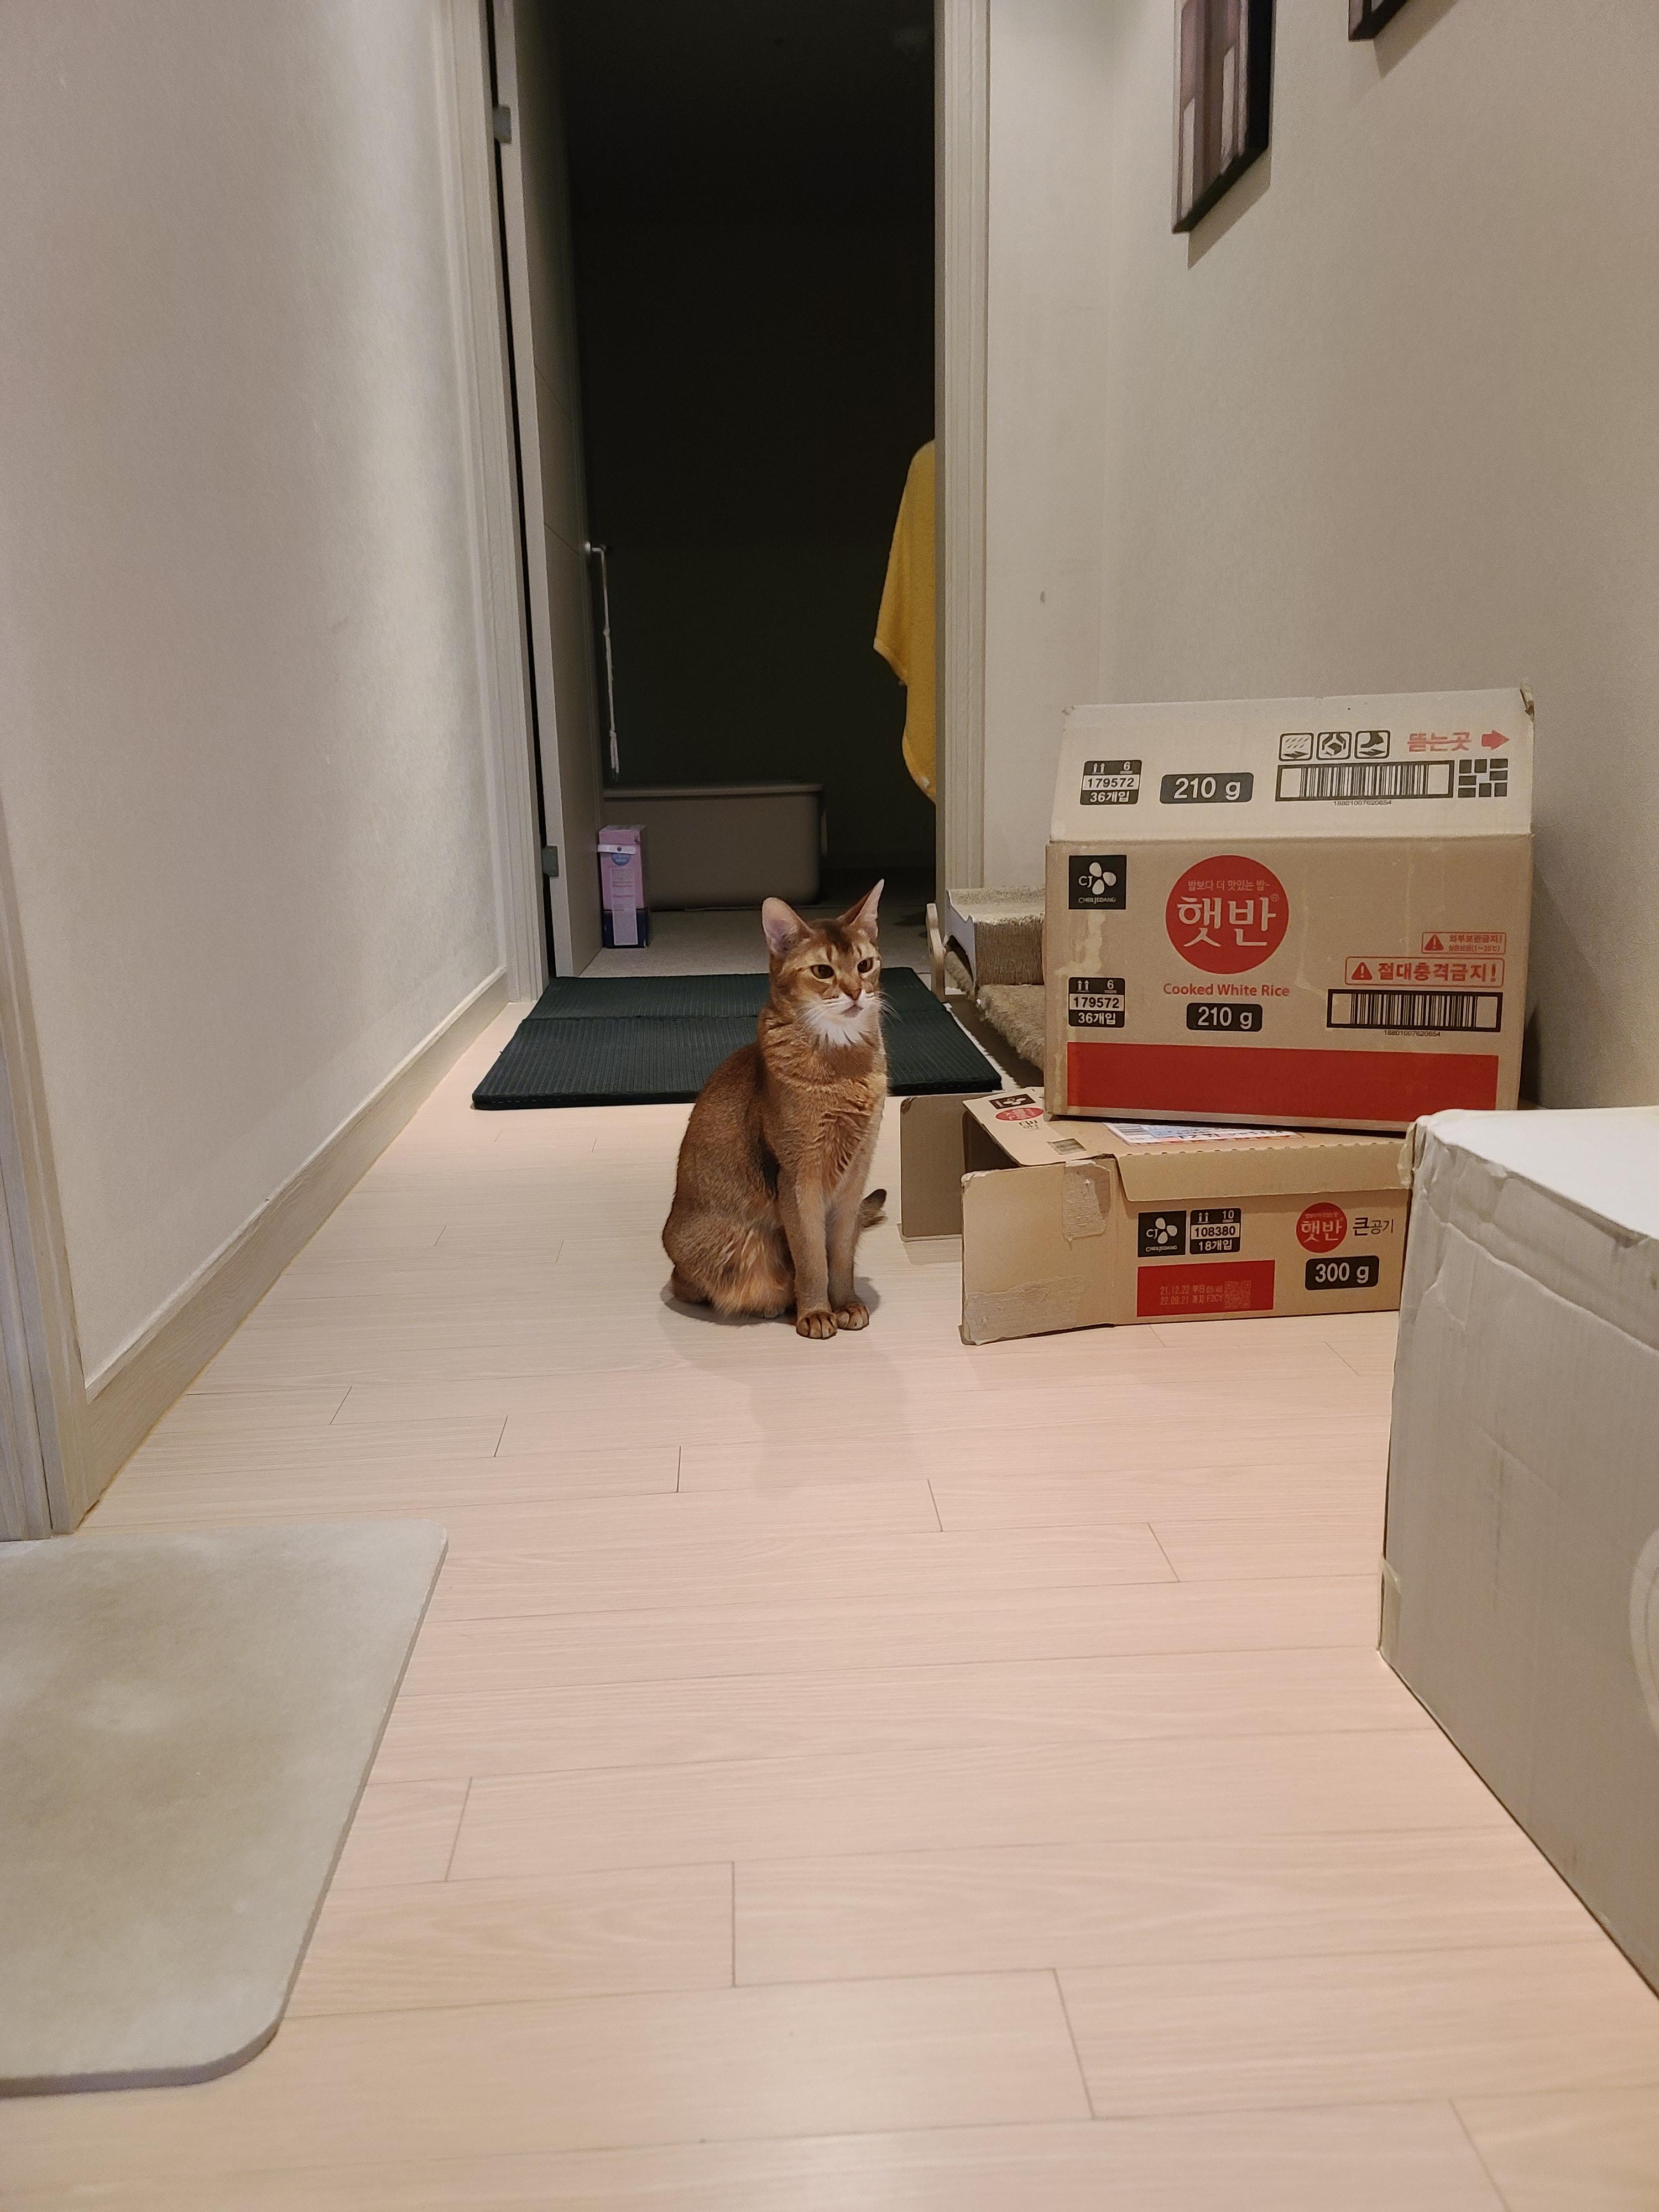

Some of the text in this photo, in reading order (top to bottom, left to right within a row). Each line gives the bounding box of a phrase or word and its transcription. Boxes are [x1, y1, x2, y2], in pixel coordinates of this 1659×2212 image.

[1123, 761, 1131, 771] 6
[1088, 778, 1134, 788] 179572
[1173, 776, 1241, 800] 210 g
[1090, 791, 1130, 802] 36개입
[1078, 875, 1093, 888] CJ
[1188, 880, 1214, 891] 밥보다
[1217, 880, 1225, 890] 더
[1228, 880, 1254, 891] 맛있는
[1177, 896, 1276, 947] 햇반
[1378, 962, 1496, 982] 절대충격금지!
[1107, 980, 1114, 989] 6
[1163, 983, 1290, 997] Cooked White Rice
[1073, 997, 1119, 1009] 179572
[1078, 1012, 1116, 1025] 36개입
[1198, 1006, 1253, 1030] 210 g
[1222, 1209, 1234, 1219] 10
[1146, 1229, 1159, 1239] CJ
[1195, 1225, 1236, 1237] 108380
[1301, 1217, 1394, 1243] 햇반 큰공기
[1198, 1239, 1233, 1251] 18개입
[1315, 1262, 1369, 1284] 300 g
[1160, 1285, 1190, 1295] 21.12.22
[1160, 1296, 1188, 1305] 22.09.21
